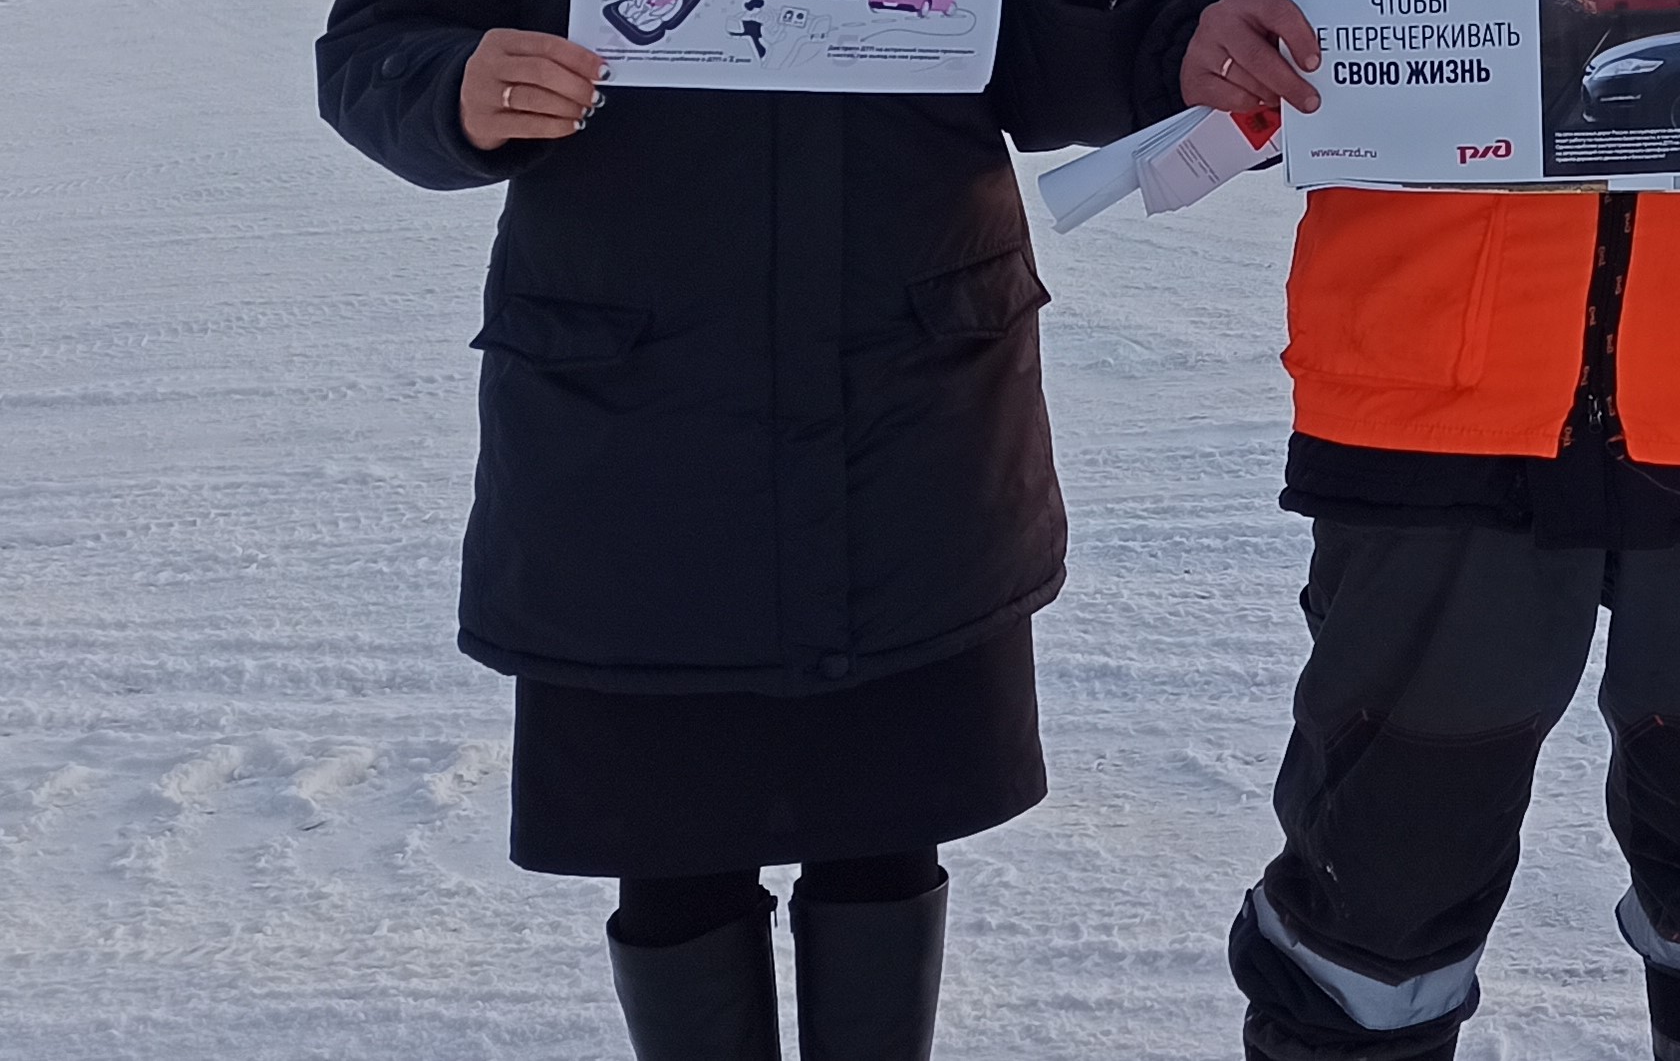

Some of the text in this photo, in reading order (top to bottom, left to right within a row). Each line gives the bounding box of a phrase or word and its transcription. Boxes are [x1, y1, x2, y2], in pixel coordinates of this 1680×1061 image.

[1316, 22, 1521, 51] Е ПЕРЕЧЕРКИВАТЬ
[1333, 59, 1491, 85] СВОЮ ЖИЗНЬ
[1310, 147, 1378, 158] www.rzd.ru
